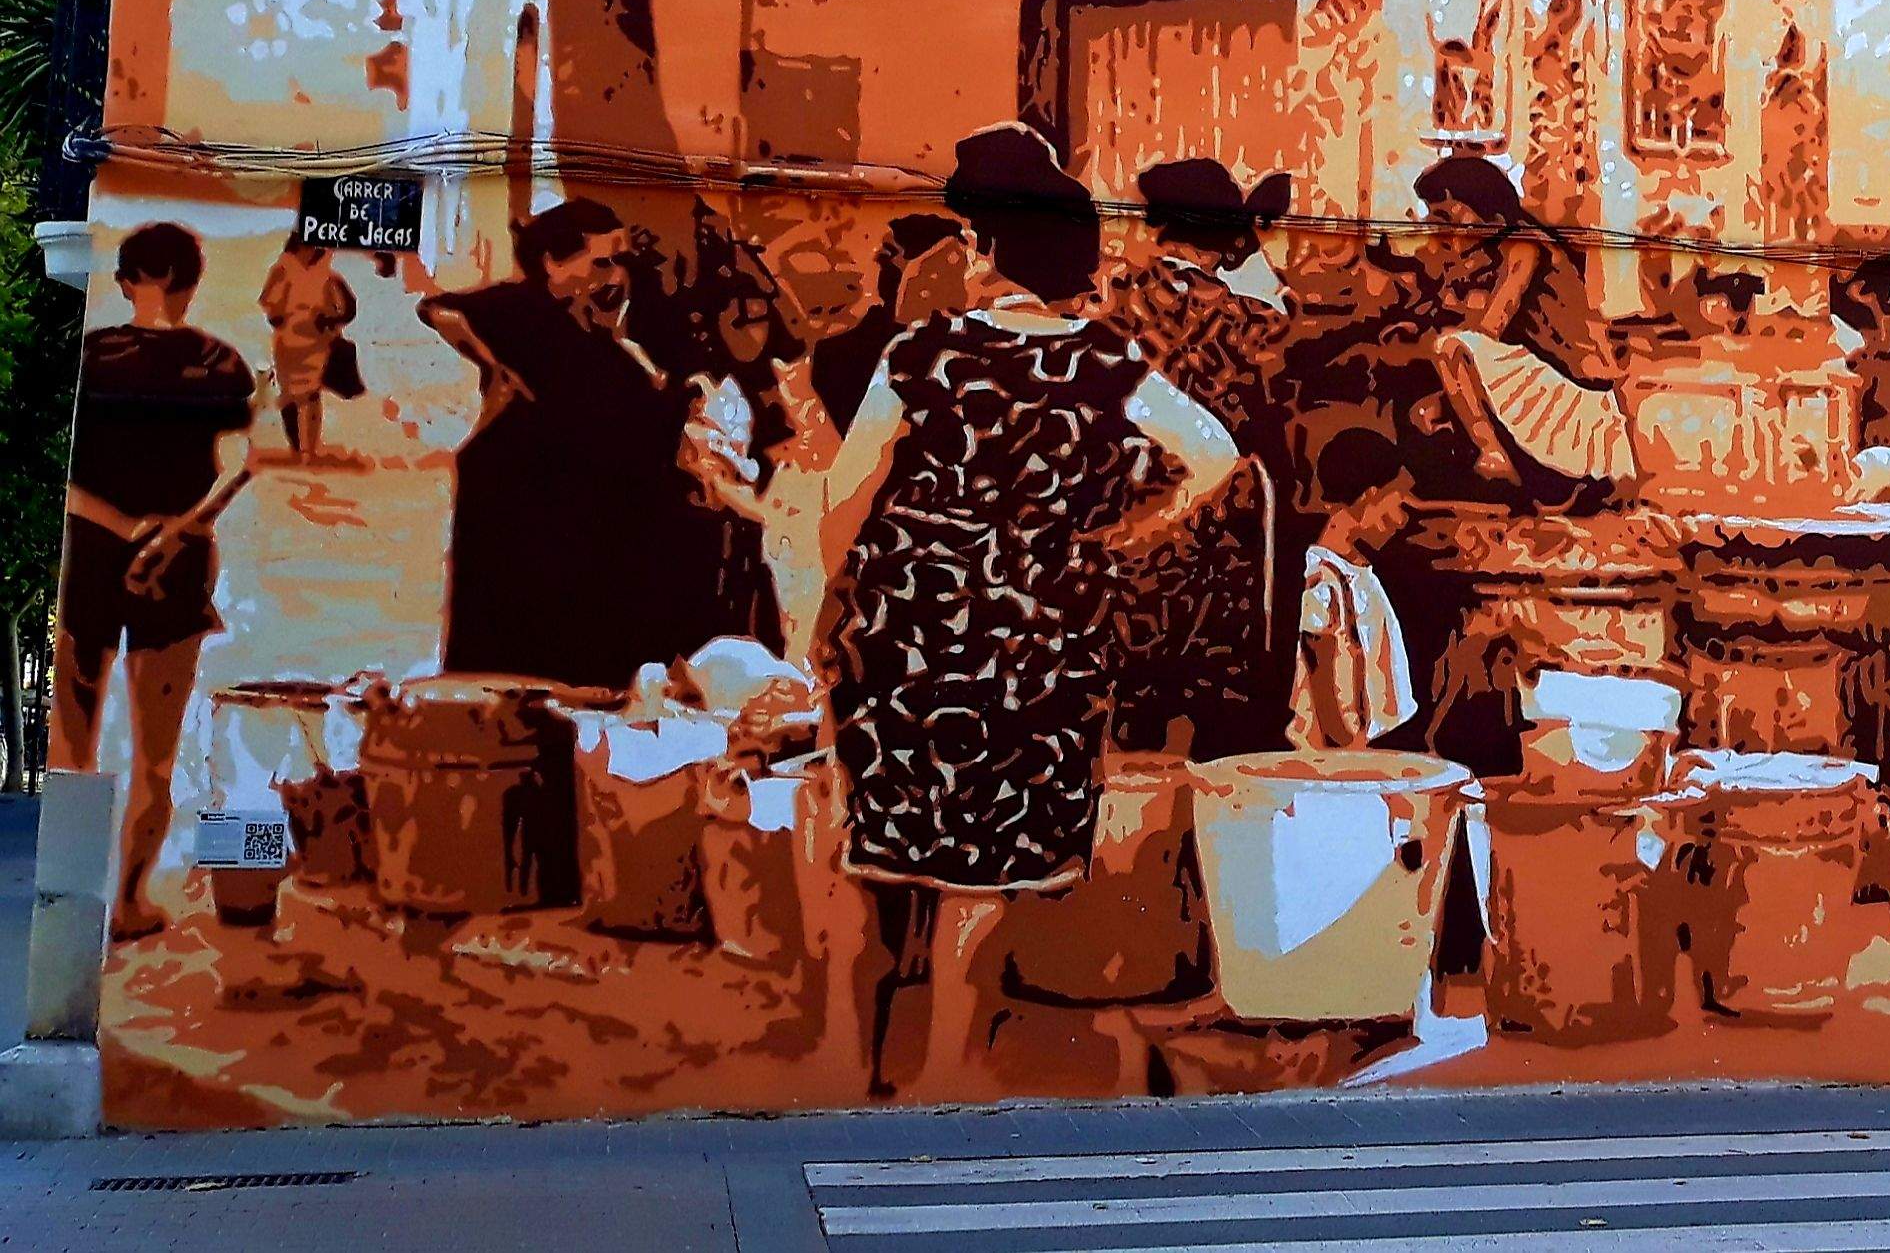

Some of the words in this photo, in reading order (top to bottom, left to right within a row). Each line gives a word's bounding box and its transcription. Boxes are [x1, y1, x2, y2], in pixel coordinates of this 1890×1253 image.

[333, 177, 393, 200] CARRER
[350, 203, 370, 221] DE
[303, 216, 348, 243] PERE
[359, 221, 413, 246] JACAS
